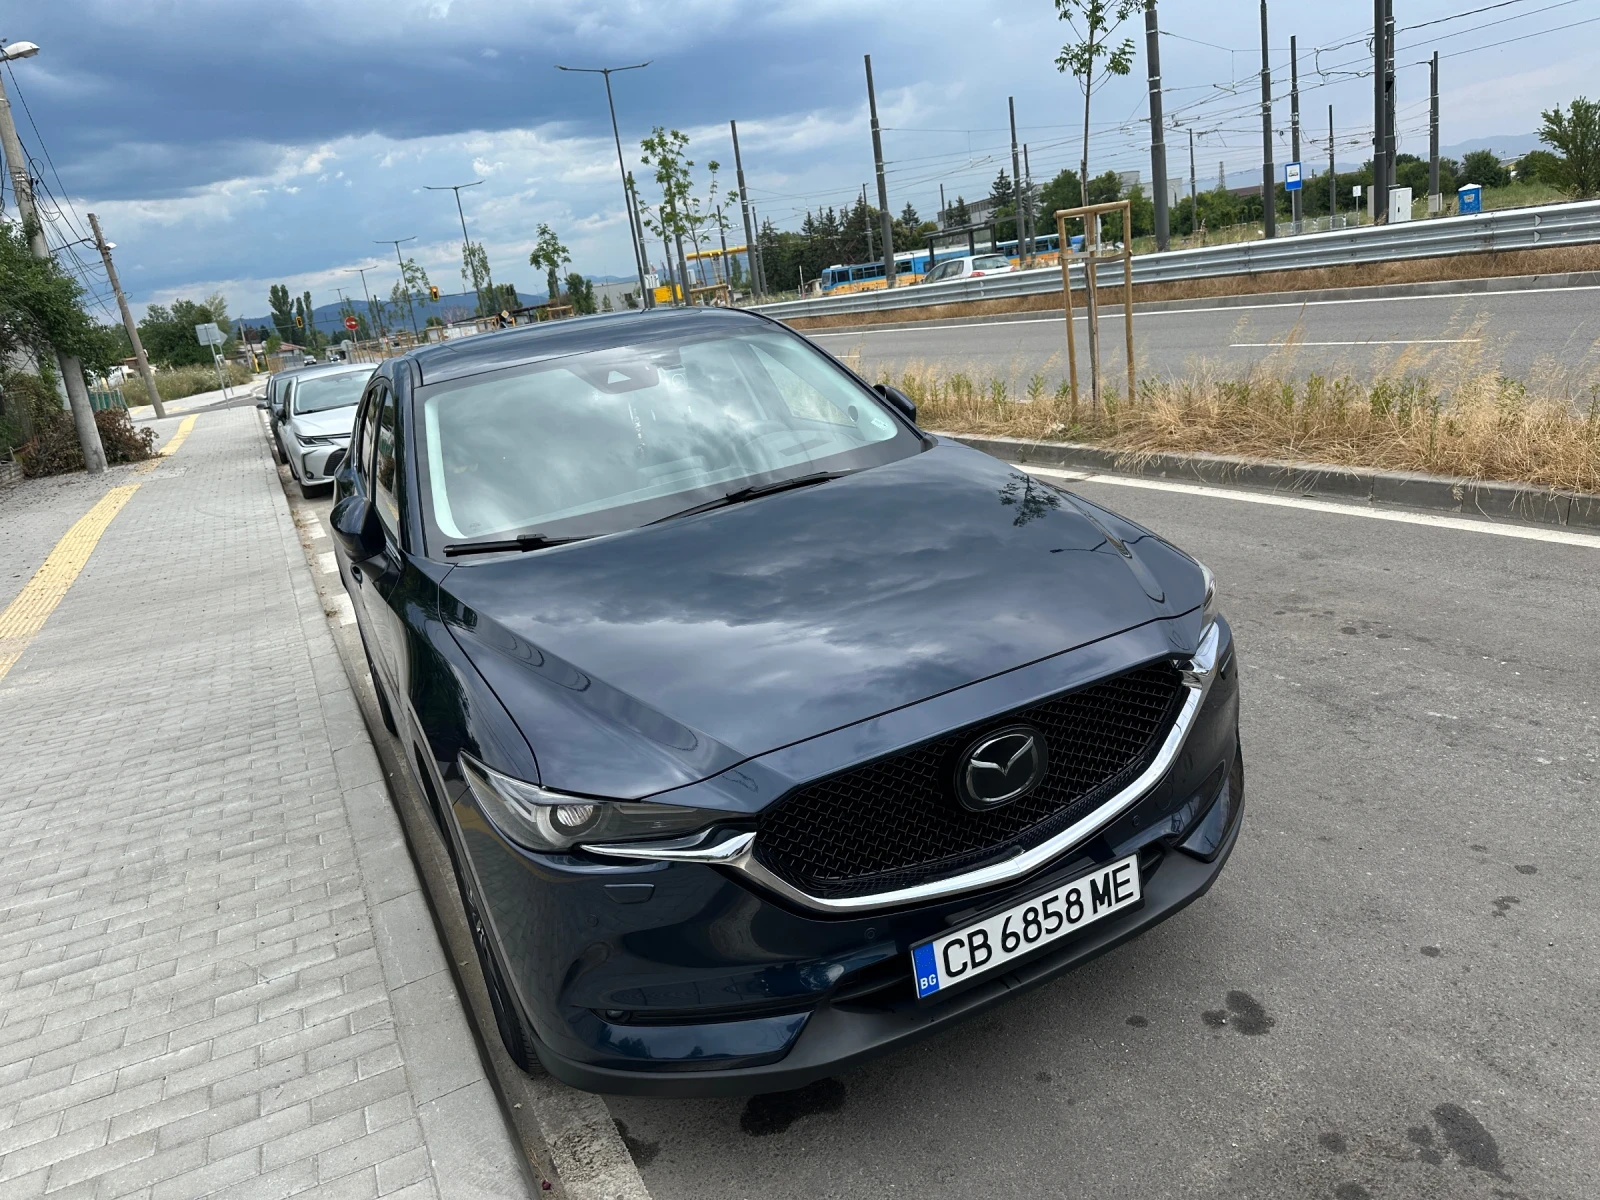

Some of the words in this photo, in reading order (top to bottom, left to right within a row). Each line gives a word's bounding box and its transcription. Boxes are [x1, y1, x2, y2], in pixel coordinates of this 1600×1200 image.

[942, 928, 992, 977] CB
[1001, 888, 1084, 953] 6858
[1090, 863, 1134, 915] ME
[920, 974, 937, 990] BG
